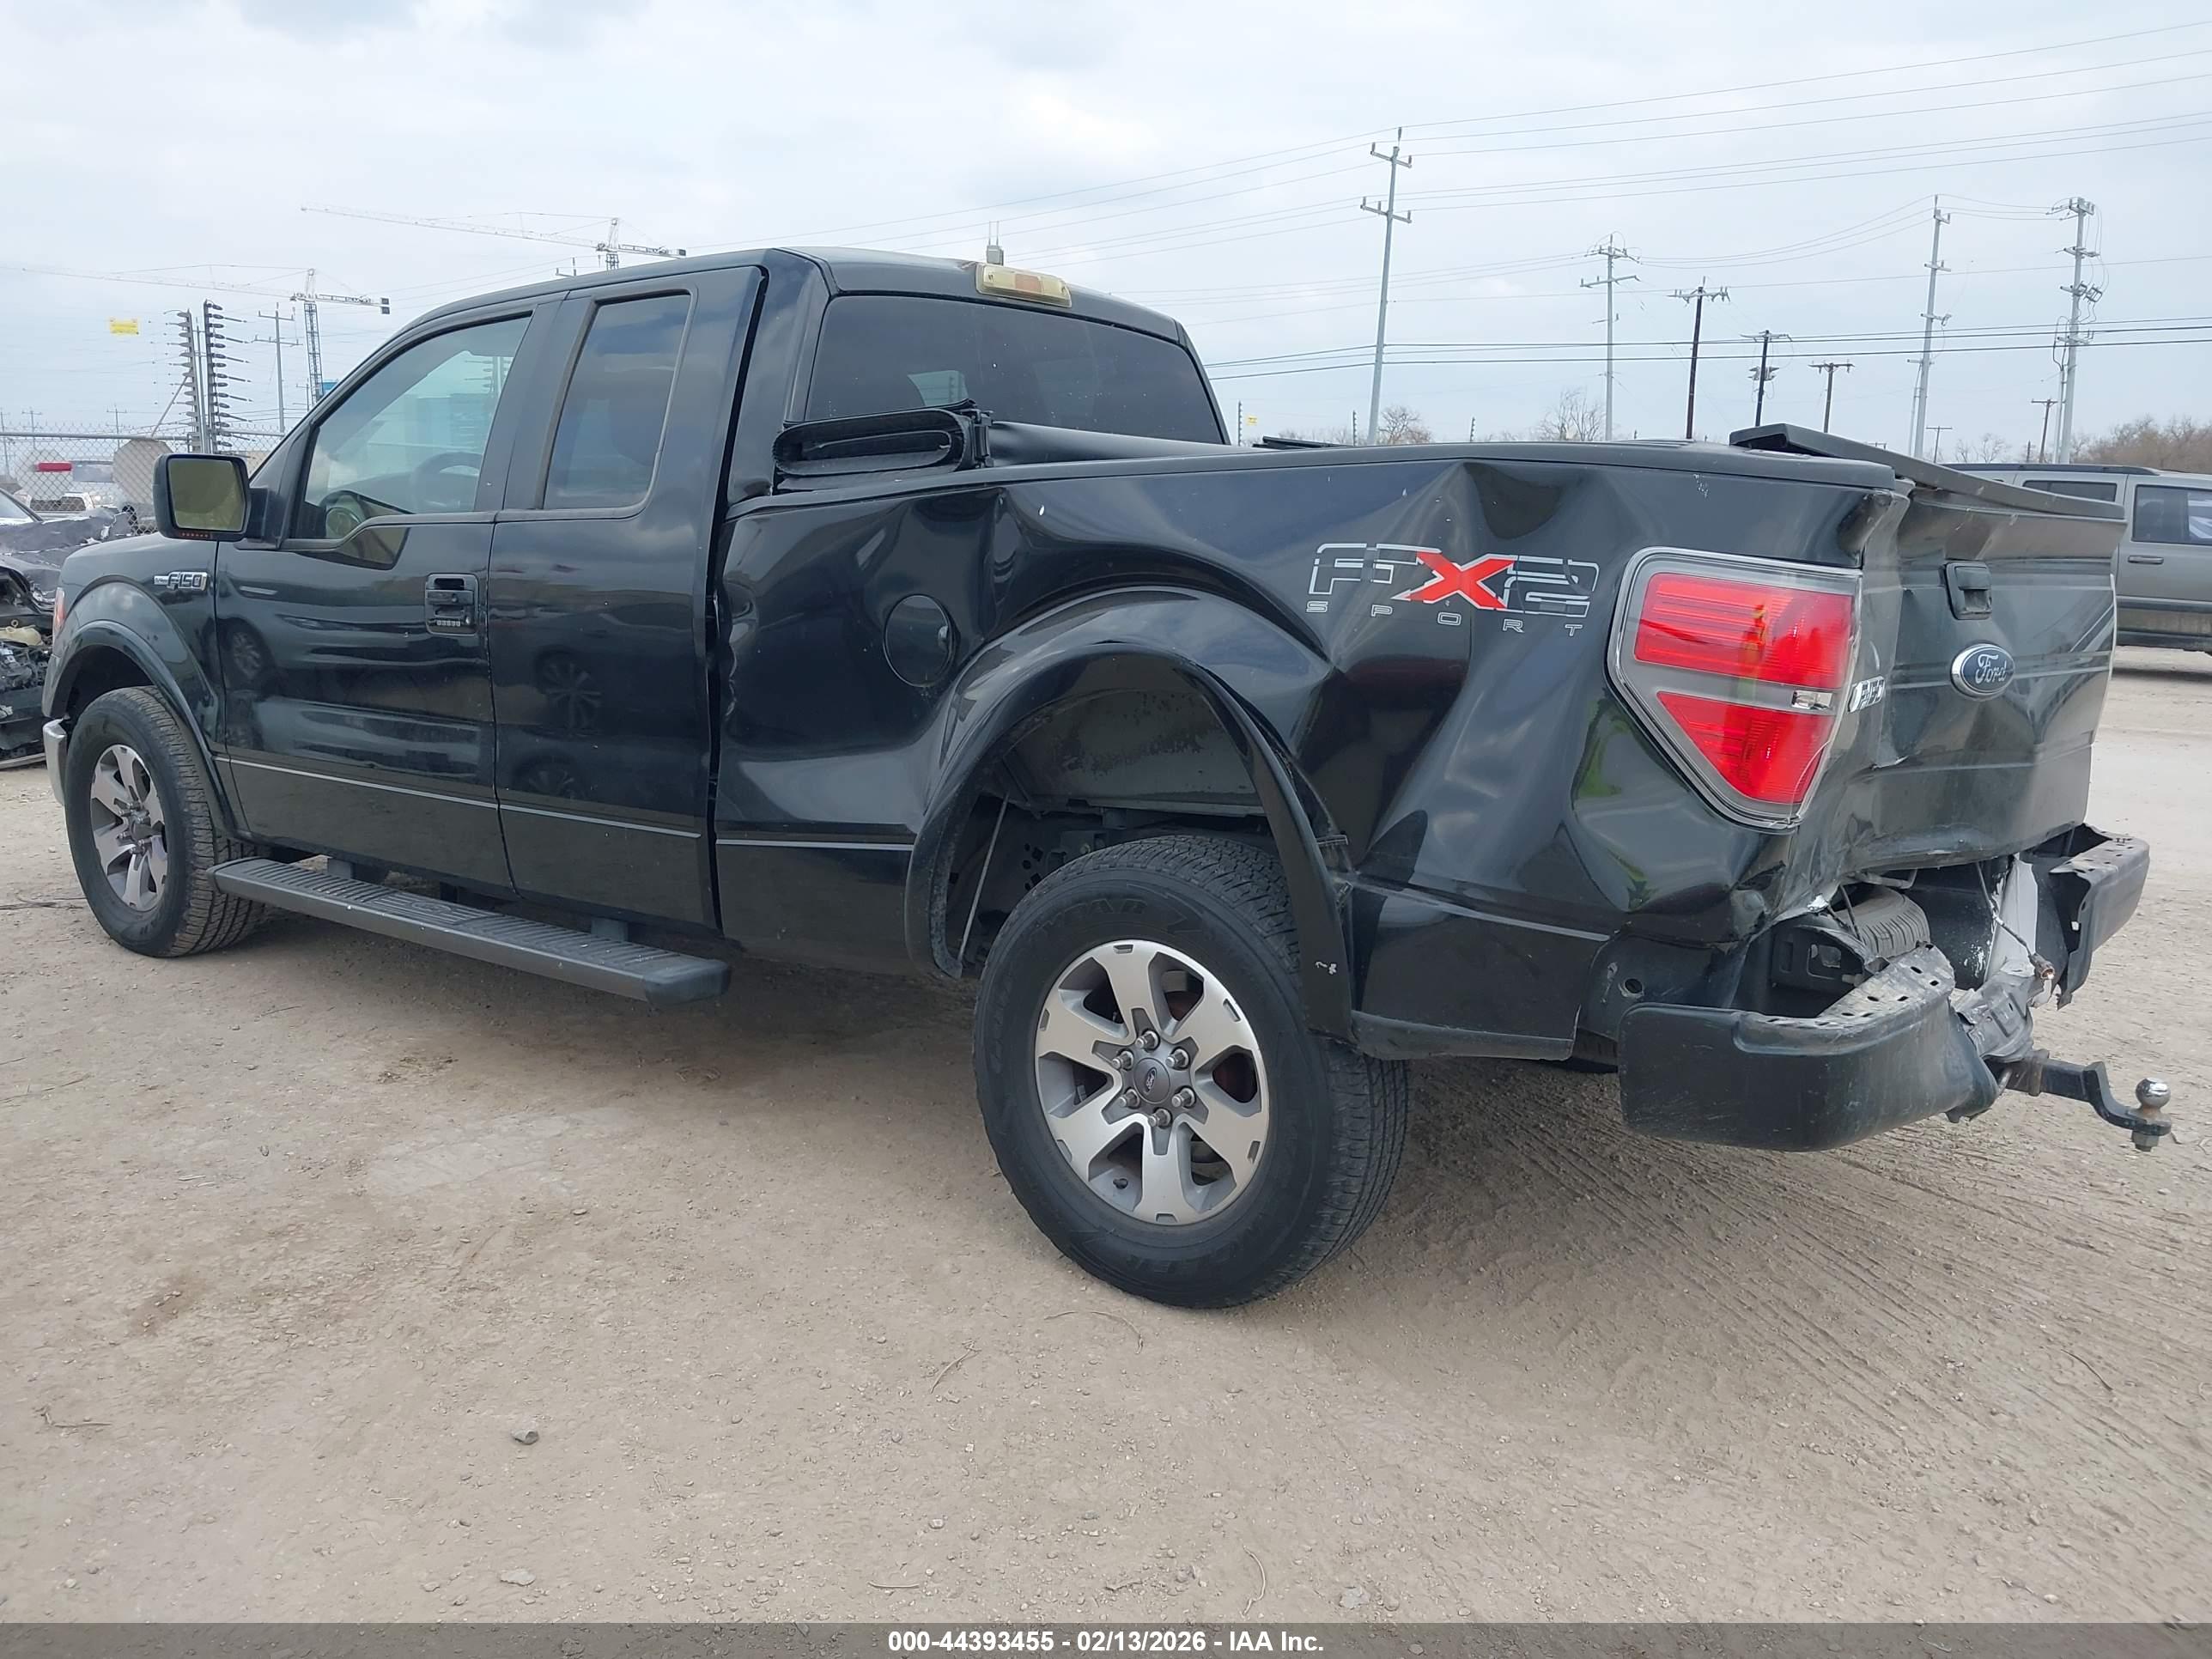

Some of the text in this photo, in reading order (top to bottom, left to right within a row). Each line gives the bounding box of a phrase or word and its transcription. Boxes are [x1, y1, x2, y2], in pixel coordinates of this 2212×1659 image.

[1308, 542, 1600, 618] FX2
[1305, 600, 1583, 637] SPORT
[1975, 653, 2008, 684] Ford
